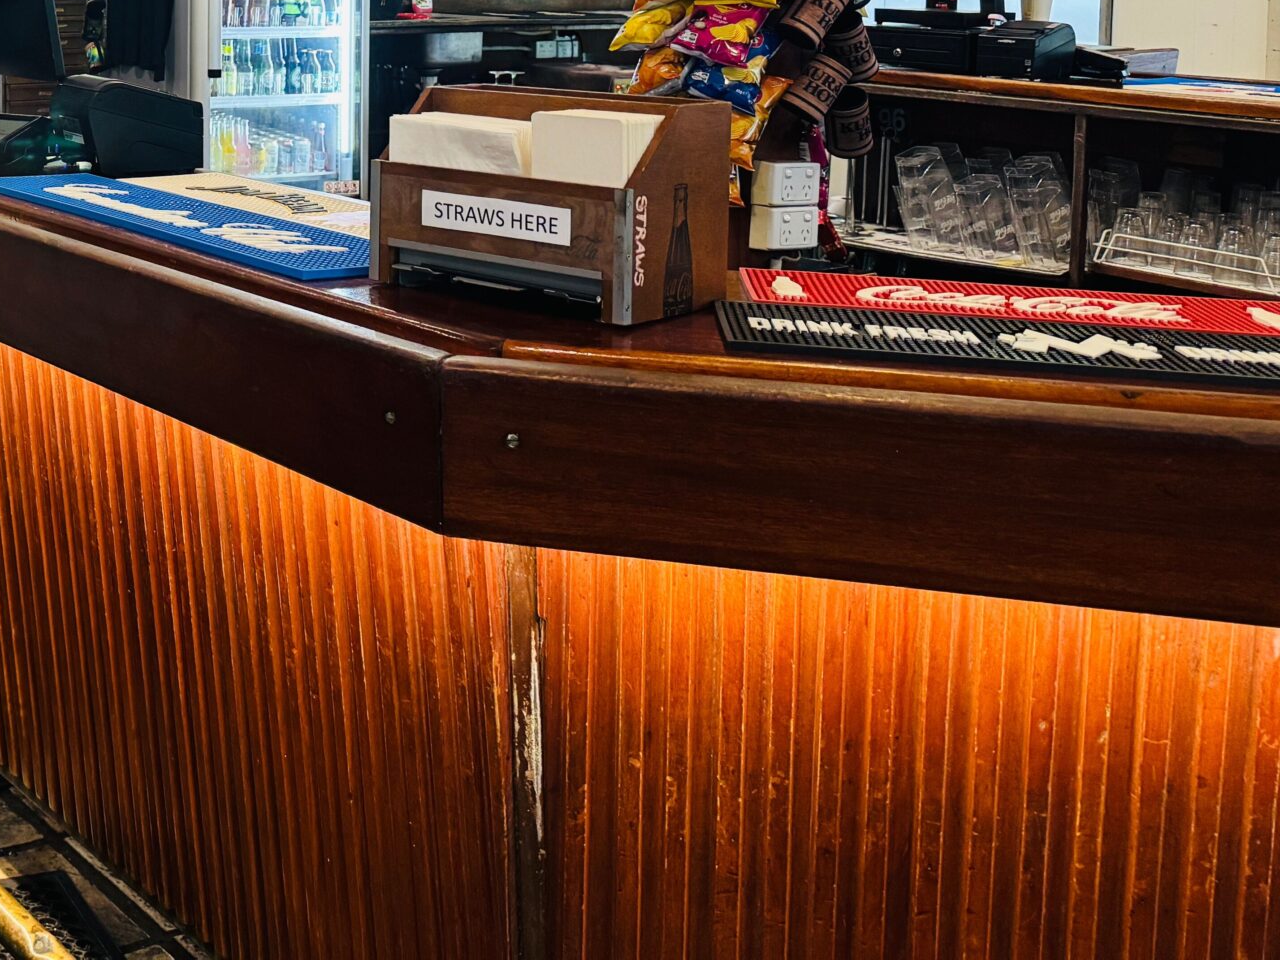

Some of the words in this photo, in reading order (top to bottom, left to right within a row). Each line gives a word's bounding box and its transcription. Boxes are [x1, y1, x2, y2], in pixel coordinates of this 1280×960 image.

[433, 201, 506, 228] STRAWS
[510, 212, 559, 235] HERE
[633, 194, 648, 288] STRAWS
[747, 316, 860, 336] DRINK
[864, 323, 981, 345] FRESH
